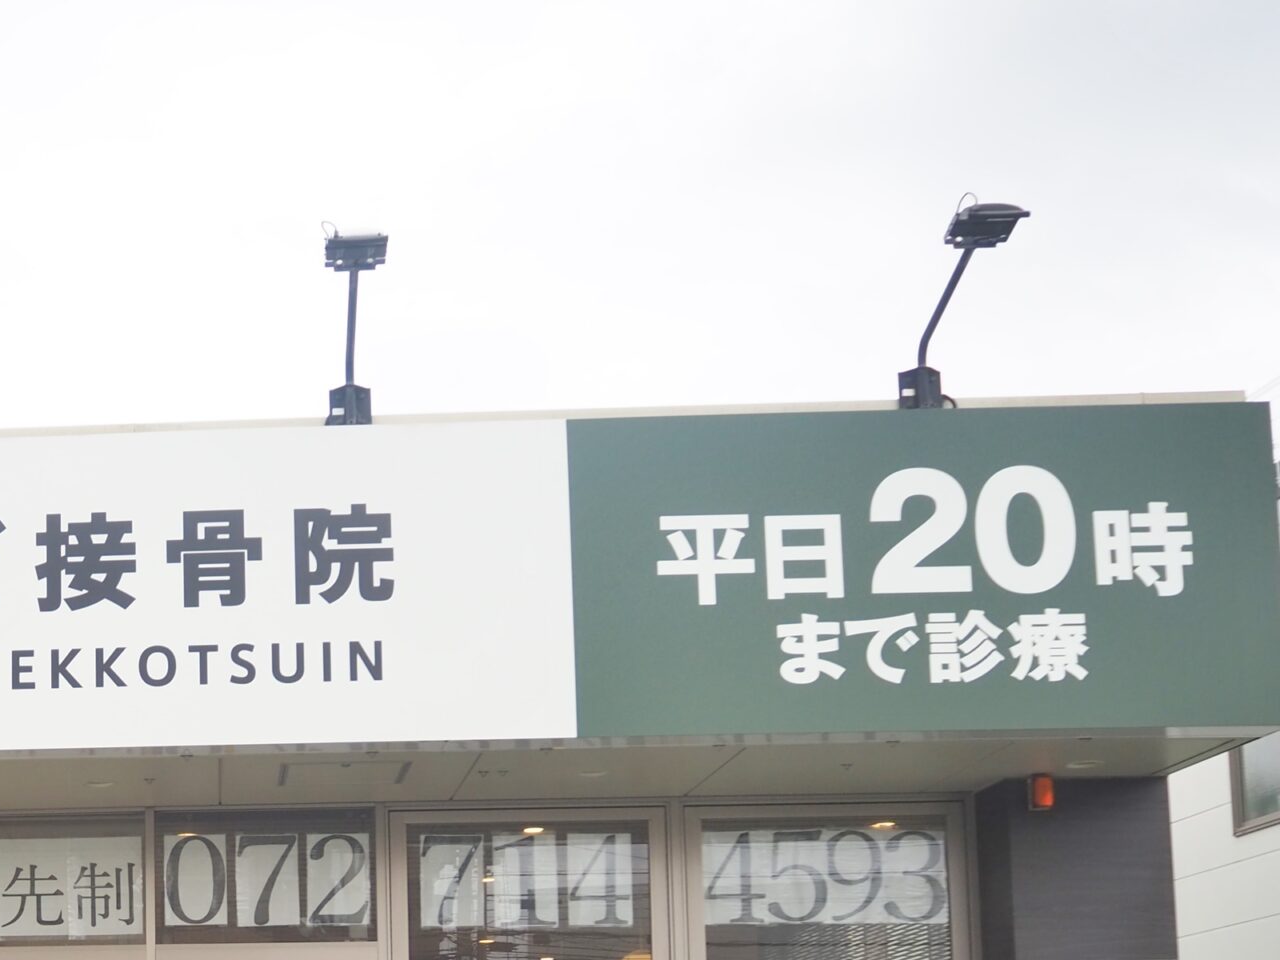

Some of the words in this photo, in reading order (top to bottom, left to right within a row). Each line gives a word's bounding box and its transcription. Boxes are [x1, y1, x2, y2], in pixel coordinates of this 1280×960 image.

[656, 464, 1194, 606] 平日20時
[776, 607, 1090, 685] まで診療
[165, 834, 371, 926] 072
[421, 834, 631, 926] 714
[705, 829, 946, 923] 4593
